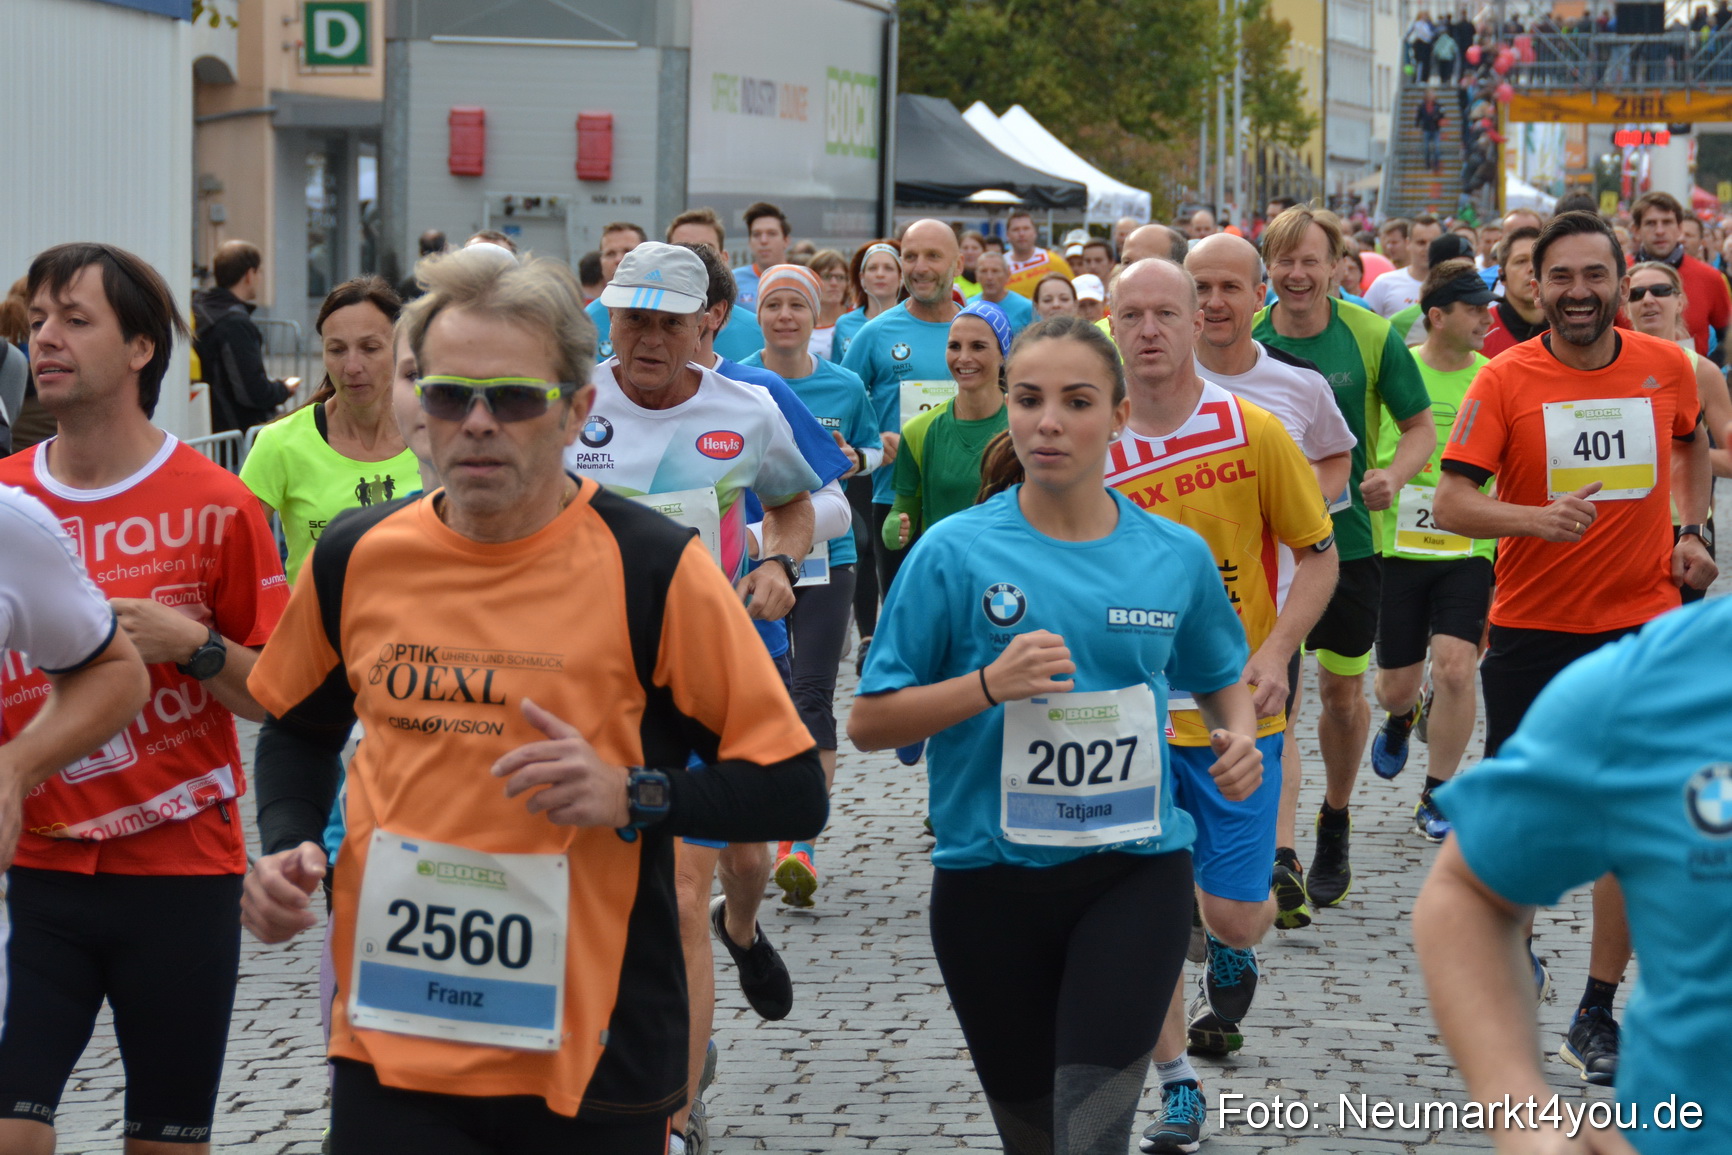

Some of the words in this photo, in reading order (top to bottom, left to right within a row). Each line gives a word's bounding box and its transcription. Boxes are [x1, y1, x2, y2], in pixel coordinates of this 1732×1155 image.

[313, 10, 361, 57] D
[1613, 96, 1673, 119] ZIEL
[1585, 408, 1622, 418] BOCK
[703, 437, 740, 453] Hervis
[1573, 429, 1626, 462] 401
[576, 453, 615, 462] PARTL
[1174, 458, 1257, 497] BÖGL
[1423, 536, 1446, 546] Klaus
[97, 554, 186, 583] schenken
[985, 584, 1023, 598] BMW
[1108, 608, 1177, 629] BOCK
[441, 651, 479, 664] UHREN
[482, 653, 505, 665] UND
[507, 655, 565, 668] SCHMUCK
[386, 662, 507, 706] OEXL
[1065, 704, 1120, 721] BOCK
[388, 716, 423, 732] CIBA
[440, 717, 505, 736] VISION
[1027, 736, 1139, 788] 2027
[1010, 777, 1017, 787] C
[1056, 802, 1113, 823] Tatjana
[436, 862, 507, 886] BOCK
[386, 898, 533, 970] 2560
[366, 942, 373, 953] D
[427, 981, 485, 1008] Franz
[180, 1126, 208, 1140] cep
